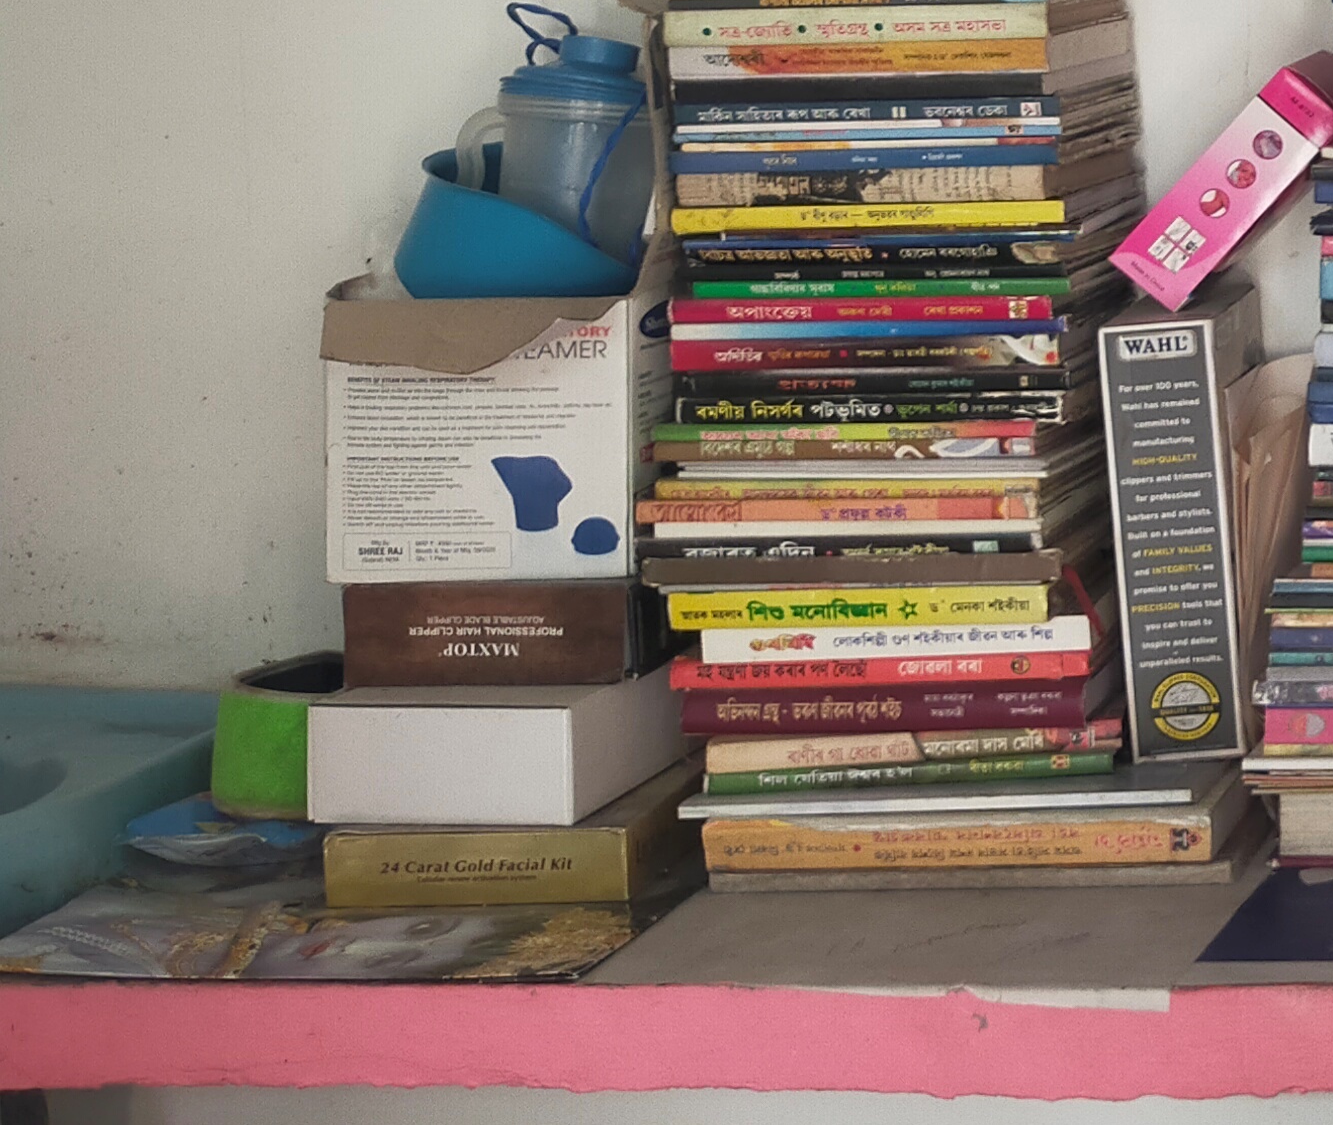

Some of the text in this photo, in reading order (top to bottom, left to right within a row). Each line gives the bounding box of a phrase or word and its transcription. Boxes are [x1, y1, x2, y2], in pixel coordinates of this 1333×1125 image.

[1124, 336, 1188, 354] WAHL
[1119, 385, 1132, 393] For
[1135, 384, 1152, 392] over
[1161, 399, 1199, 408] remained
[1181, 417, 1190, 425] to
[1143, 548, 1174, 557] FAMILY
[1178, 544, 1212, 553] VALUES
[1134, 568, 1149, 576] and
[1134, 585, 1167, 595] promise
[1132, 602, 1180, 613] PRECISION
[1205, 598, 1222, 607] that
[409, 626, 563, 636] PROFESSIONAL HAIR CLIPPER
[1144, 624, 1161, 632] you
[443, 643, 519, 656] MAXTOP
[380, 857, 572, 873] 24 Carat Gold Facial Kit
